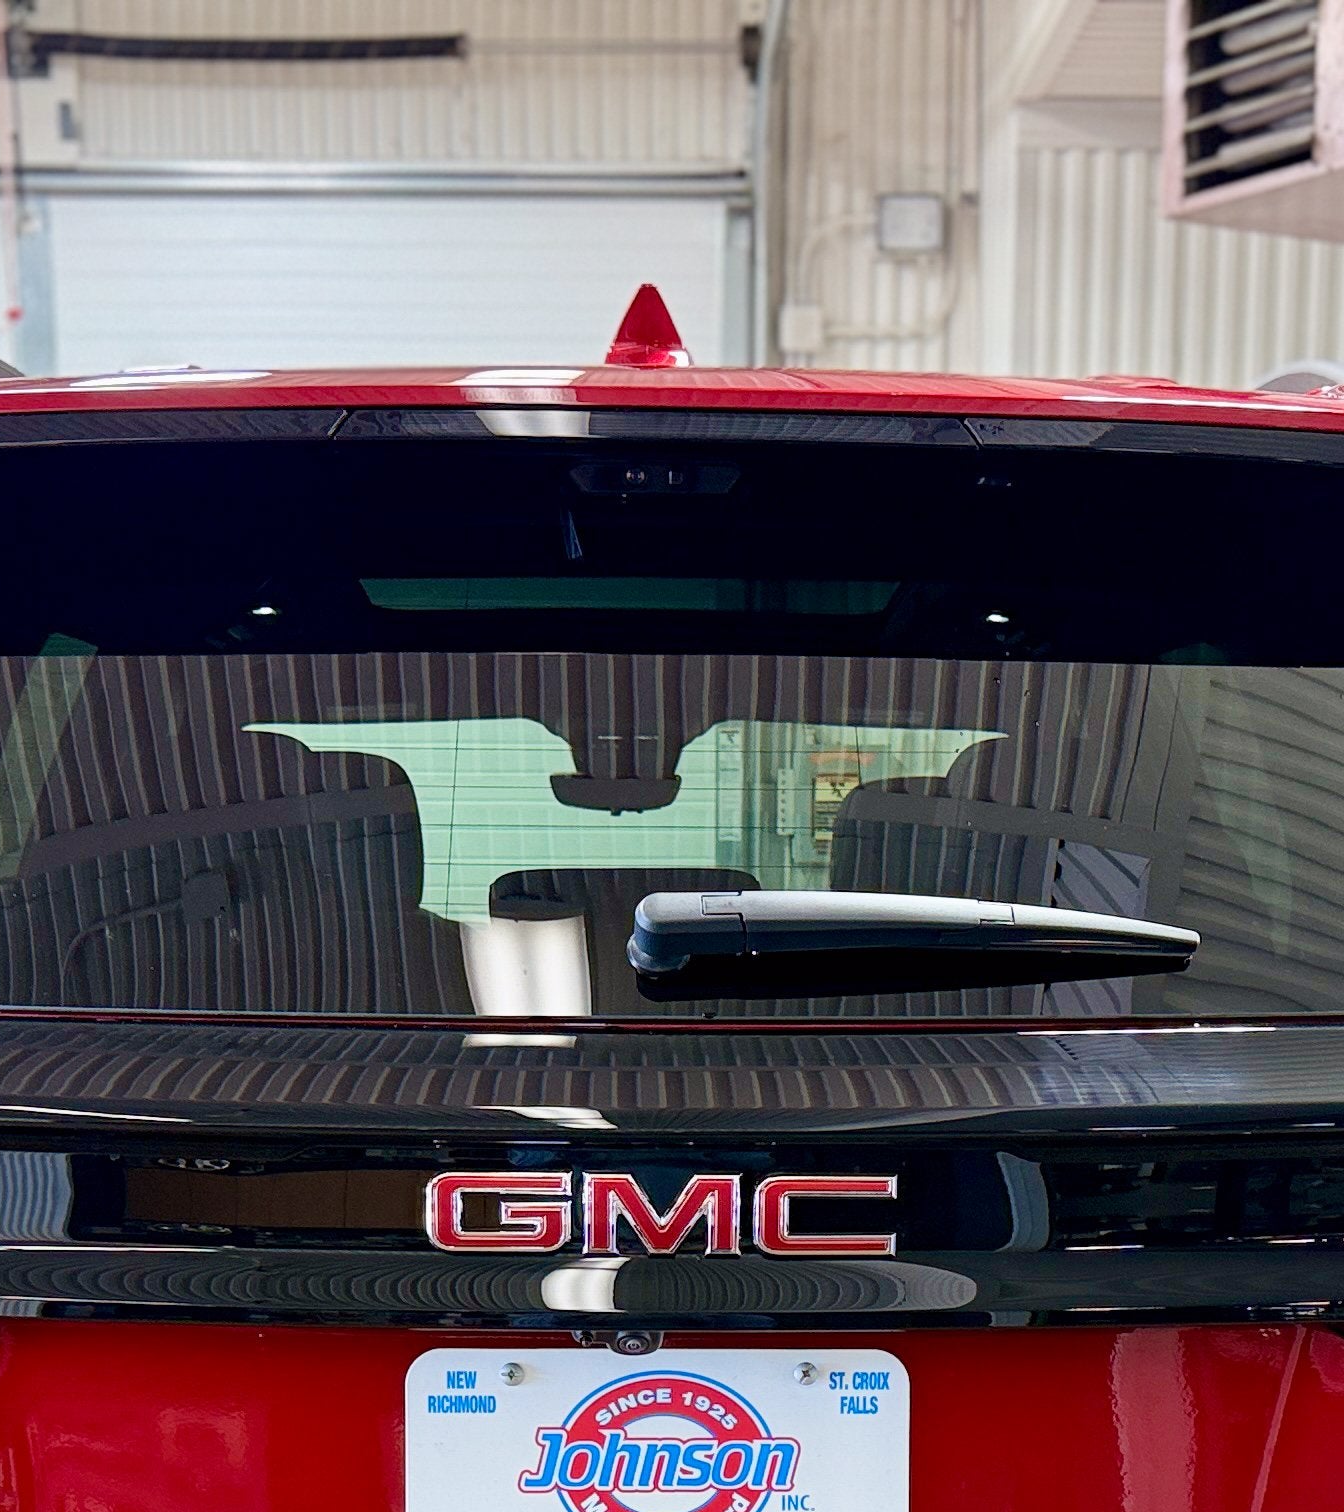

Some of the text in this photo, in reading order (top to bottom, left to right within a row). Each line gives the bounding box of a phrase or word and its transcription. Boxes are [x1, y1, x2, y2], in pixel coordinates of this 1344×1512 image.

[426, 1171, 898, 1257] GMC
[446, 1371, 477, 1389] NEW
[829, 1372, 890, 1390] ST. CROIX
[428, 1395, 497, 1413] RICHMOND
[595, 1388, 738, 1430] SINCE 1925
[840, 1396, 879, 1414] FALLS
[520, 1429, 800, 1491] Johnson
[781, 1495, 815, 1511] INC.
